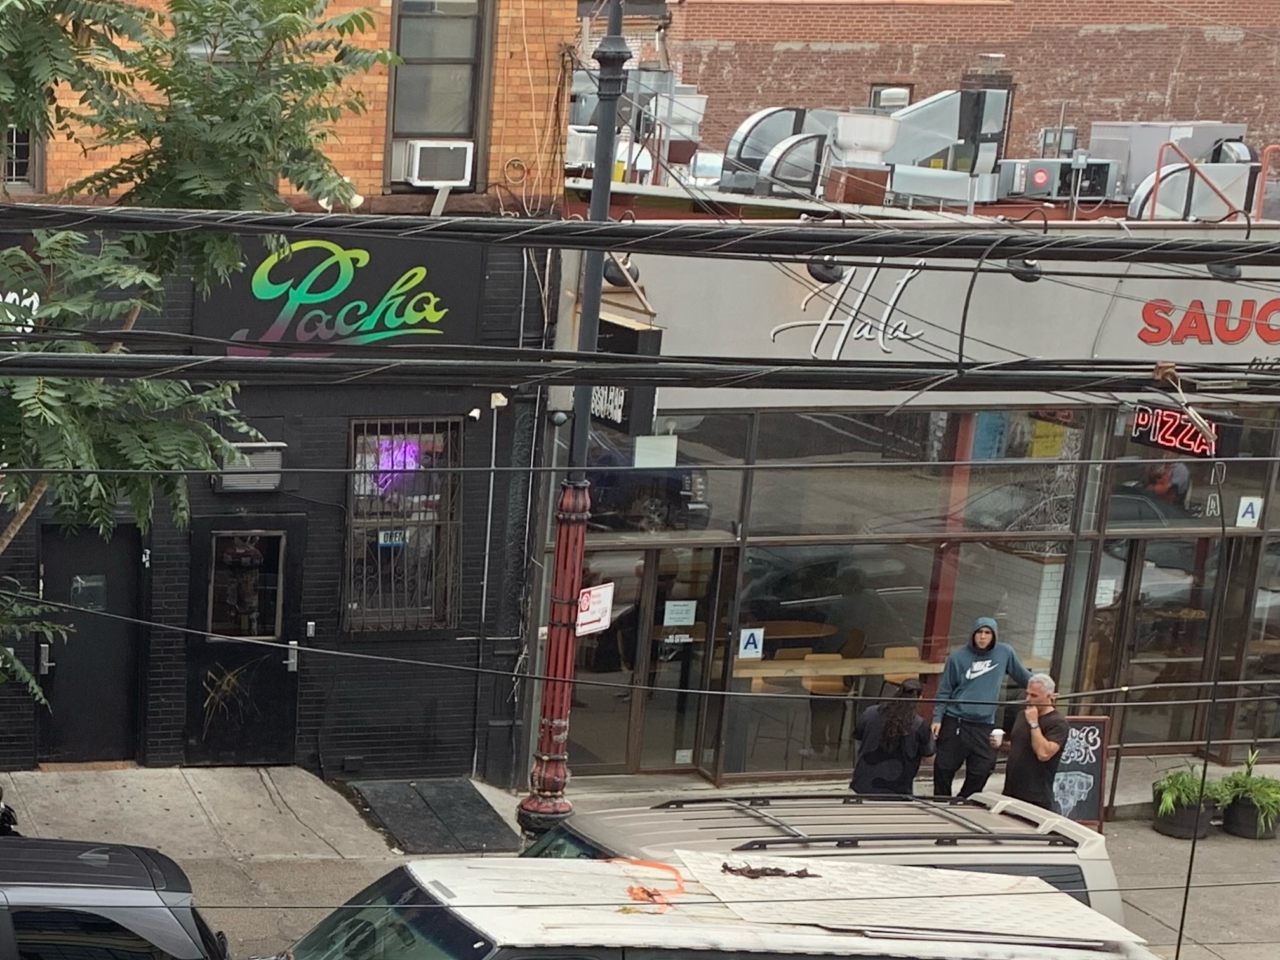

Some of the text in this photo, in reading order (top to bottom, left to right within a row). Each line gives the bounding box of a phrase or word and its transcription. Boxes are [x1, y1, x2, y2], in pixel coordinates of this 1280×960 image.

[232, 239, 440, 357] Pacha
[770, 256, 925, 360] Hala
[1131, 404, 1217, 457] PIZZA
[1241, 502, 1256, 519] A
[742, 632, 759, 650] A
